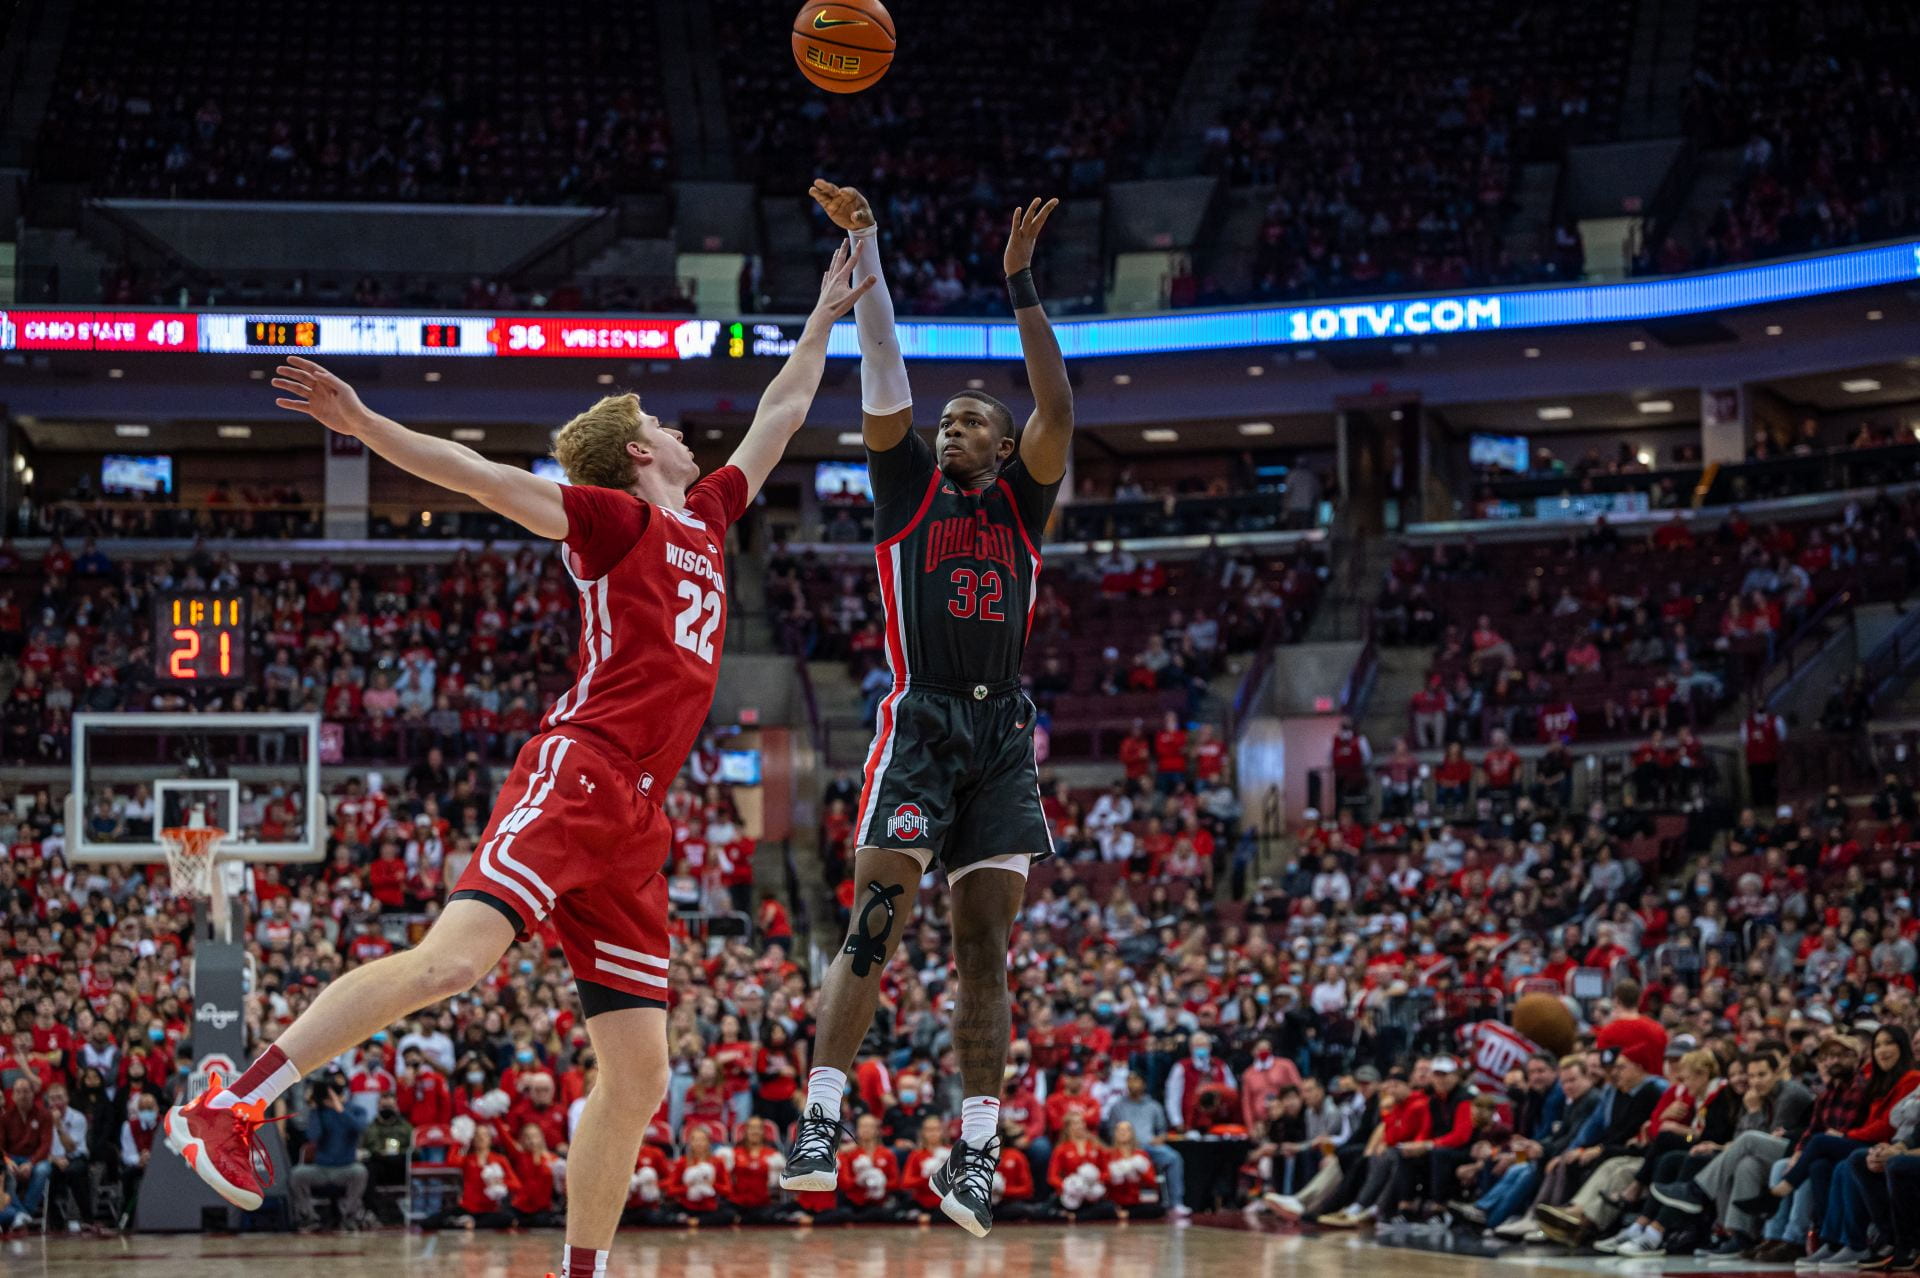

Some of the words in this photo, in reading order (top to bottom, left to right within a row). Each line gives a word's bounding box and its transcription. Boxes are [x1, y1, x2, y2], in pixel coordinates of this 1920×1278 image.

[806, 45, 861, 71] ELITE
[1290, 296, 1501, 342] 10TV.COM
[173, 599, 238, 626] 11:11
[947, 567, 1005, 622] 32
[674, 579, 722, 665] 22
[170, 629, 230, 678] 21
